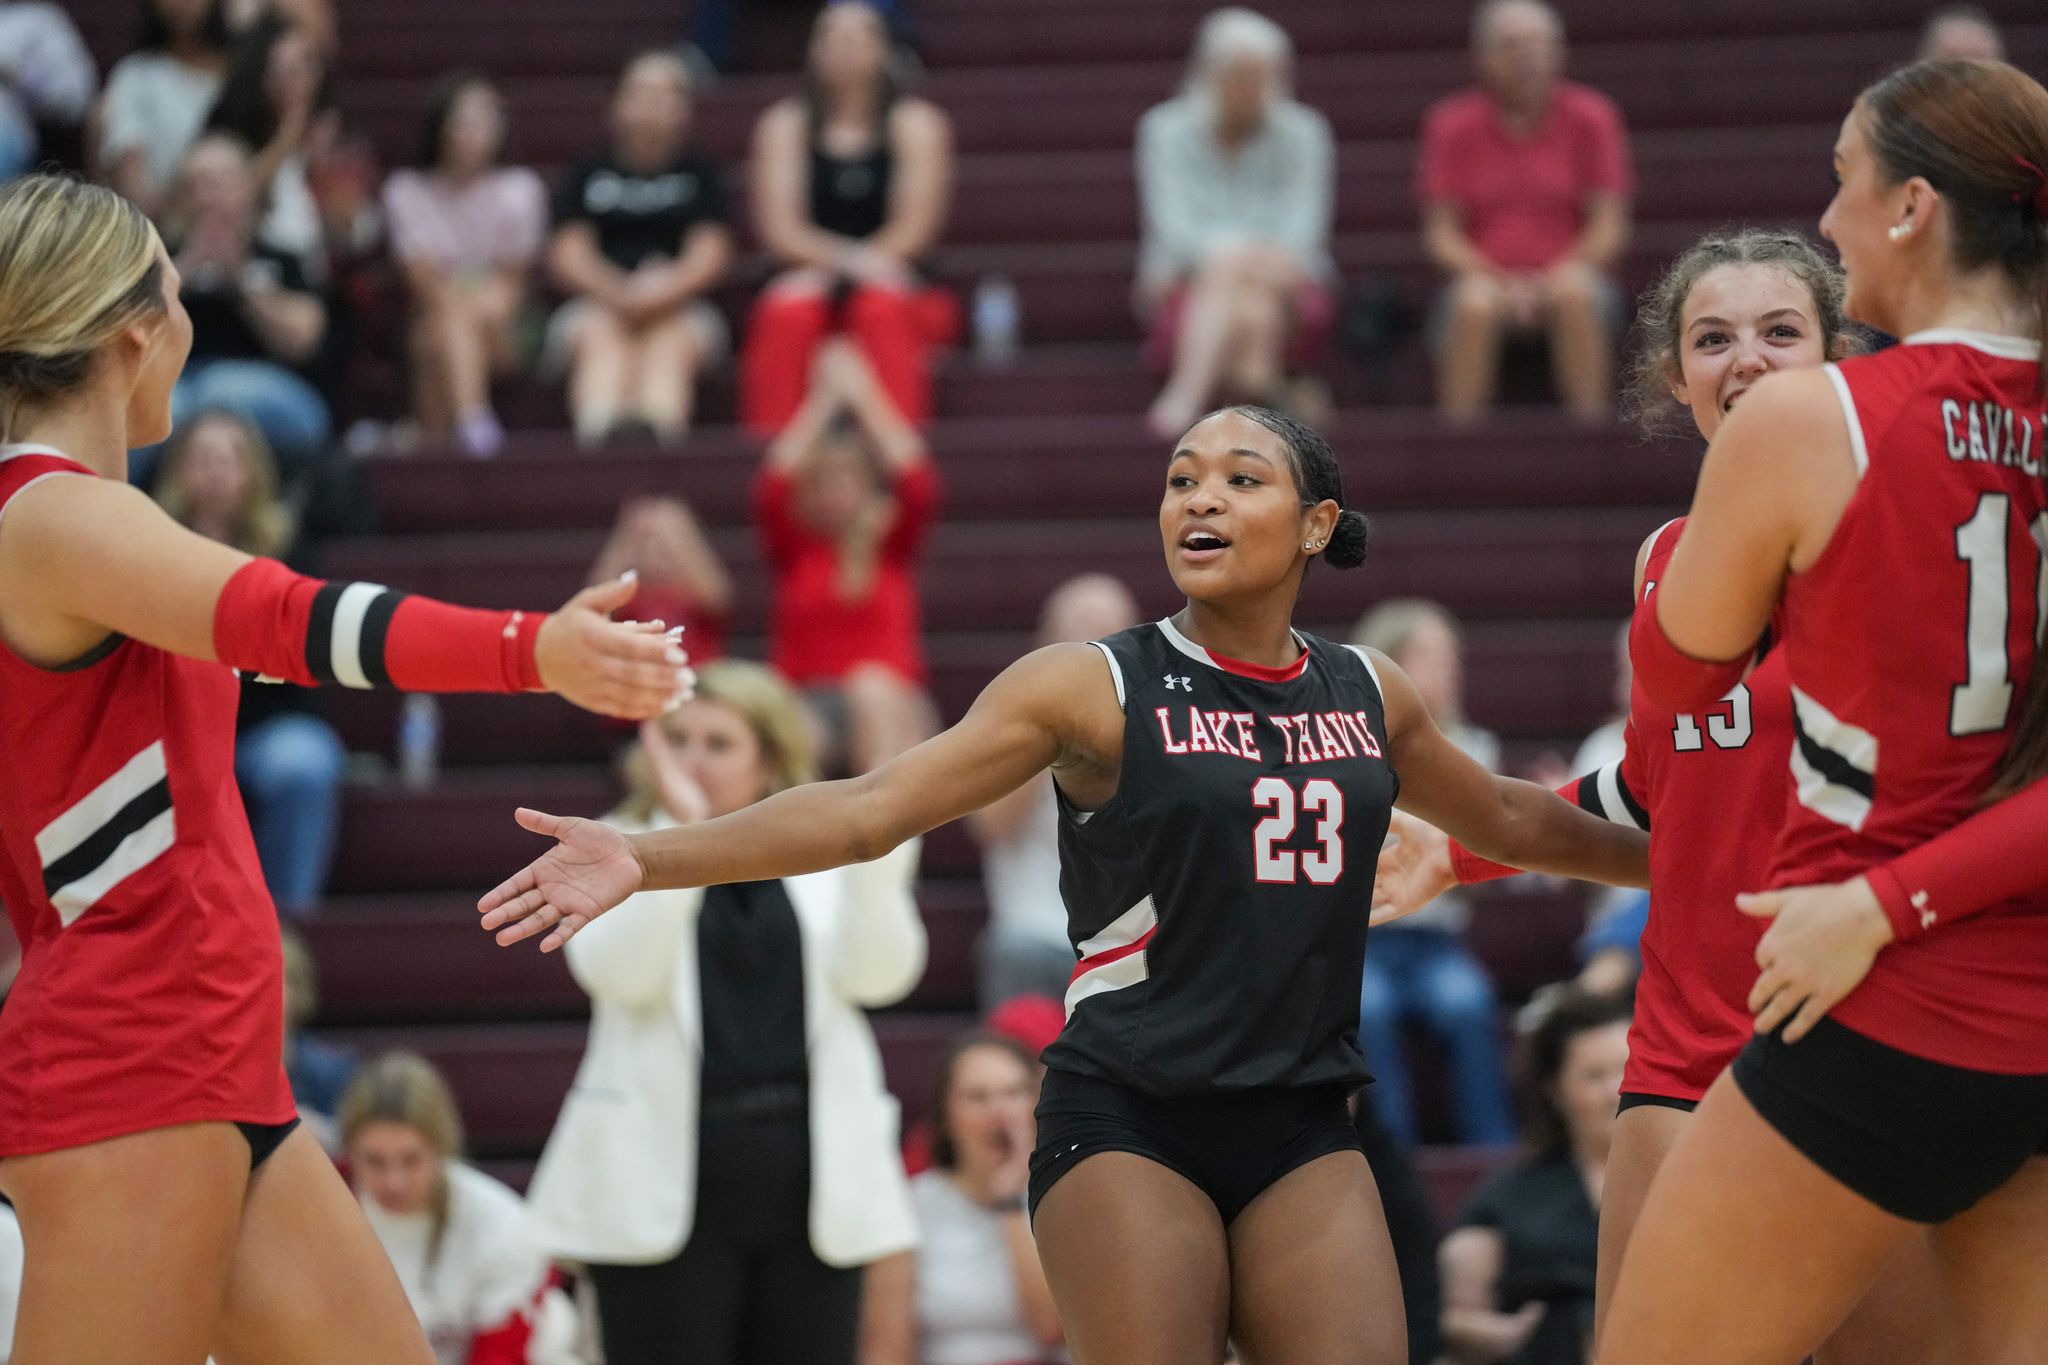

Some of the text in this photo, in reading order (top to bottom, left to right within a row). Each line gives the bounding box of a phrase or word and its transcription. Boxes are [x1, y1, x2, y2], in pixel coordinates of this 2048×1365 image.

[1941, 398, 2048, 477] CAVAL
[1949, 491, 2048, 738] 1
[1155, 705, 1382, 765] LAKE TRAVIS
[1252, 776, 1344, 885] 23
